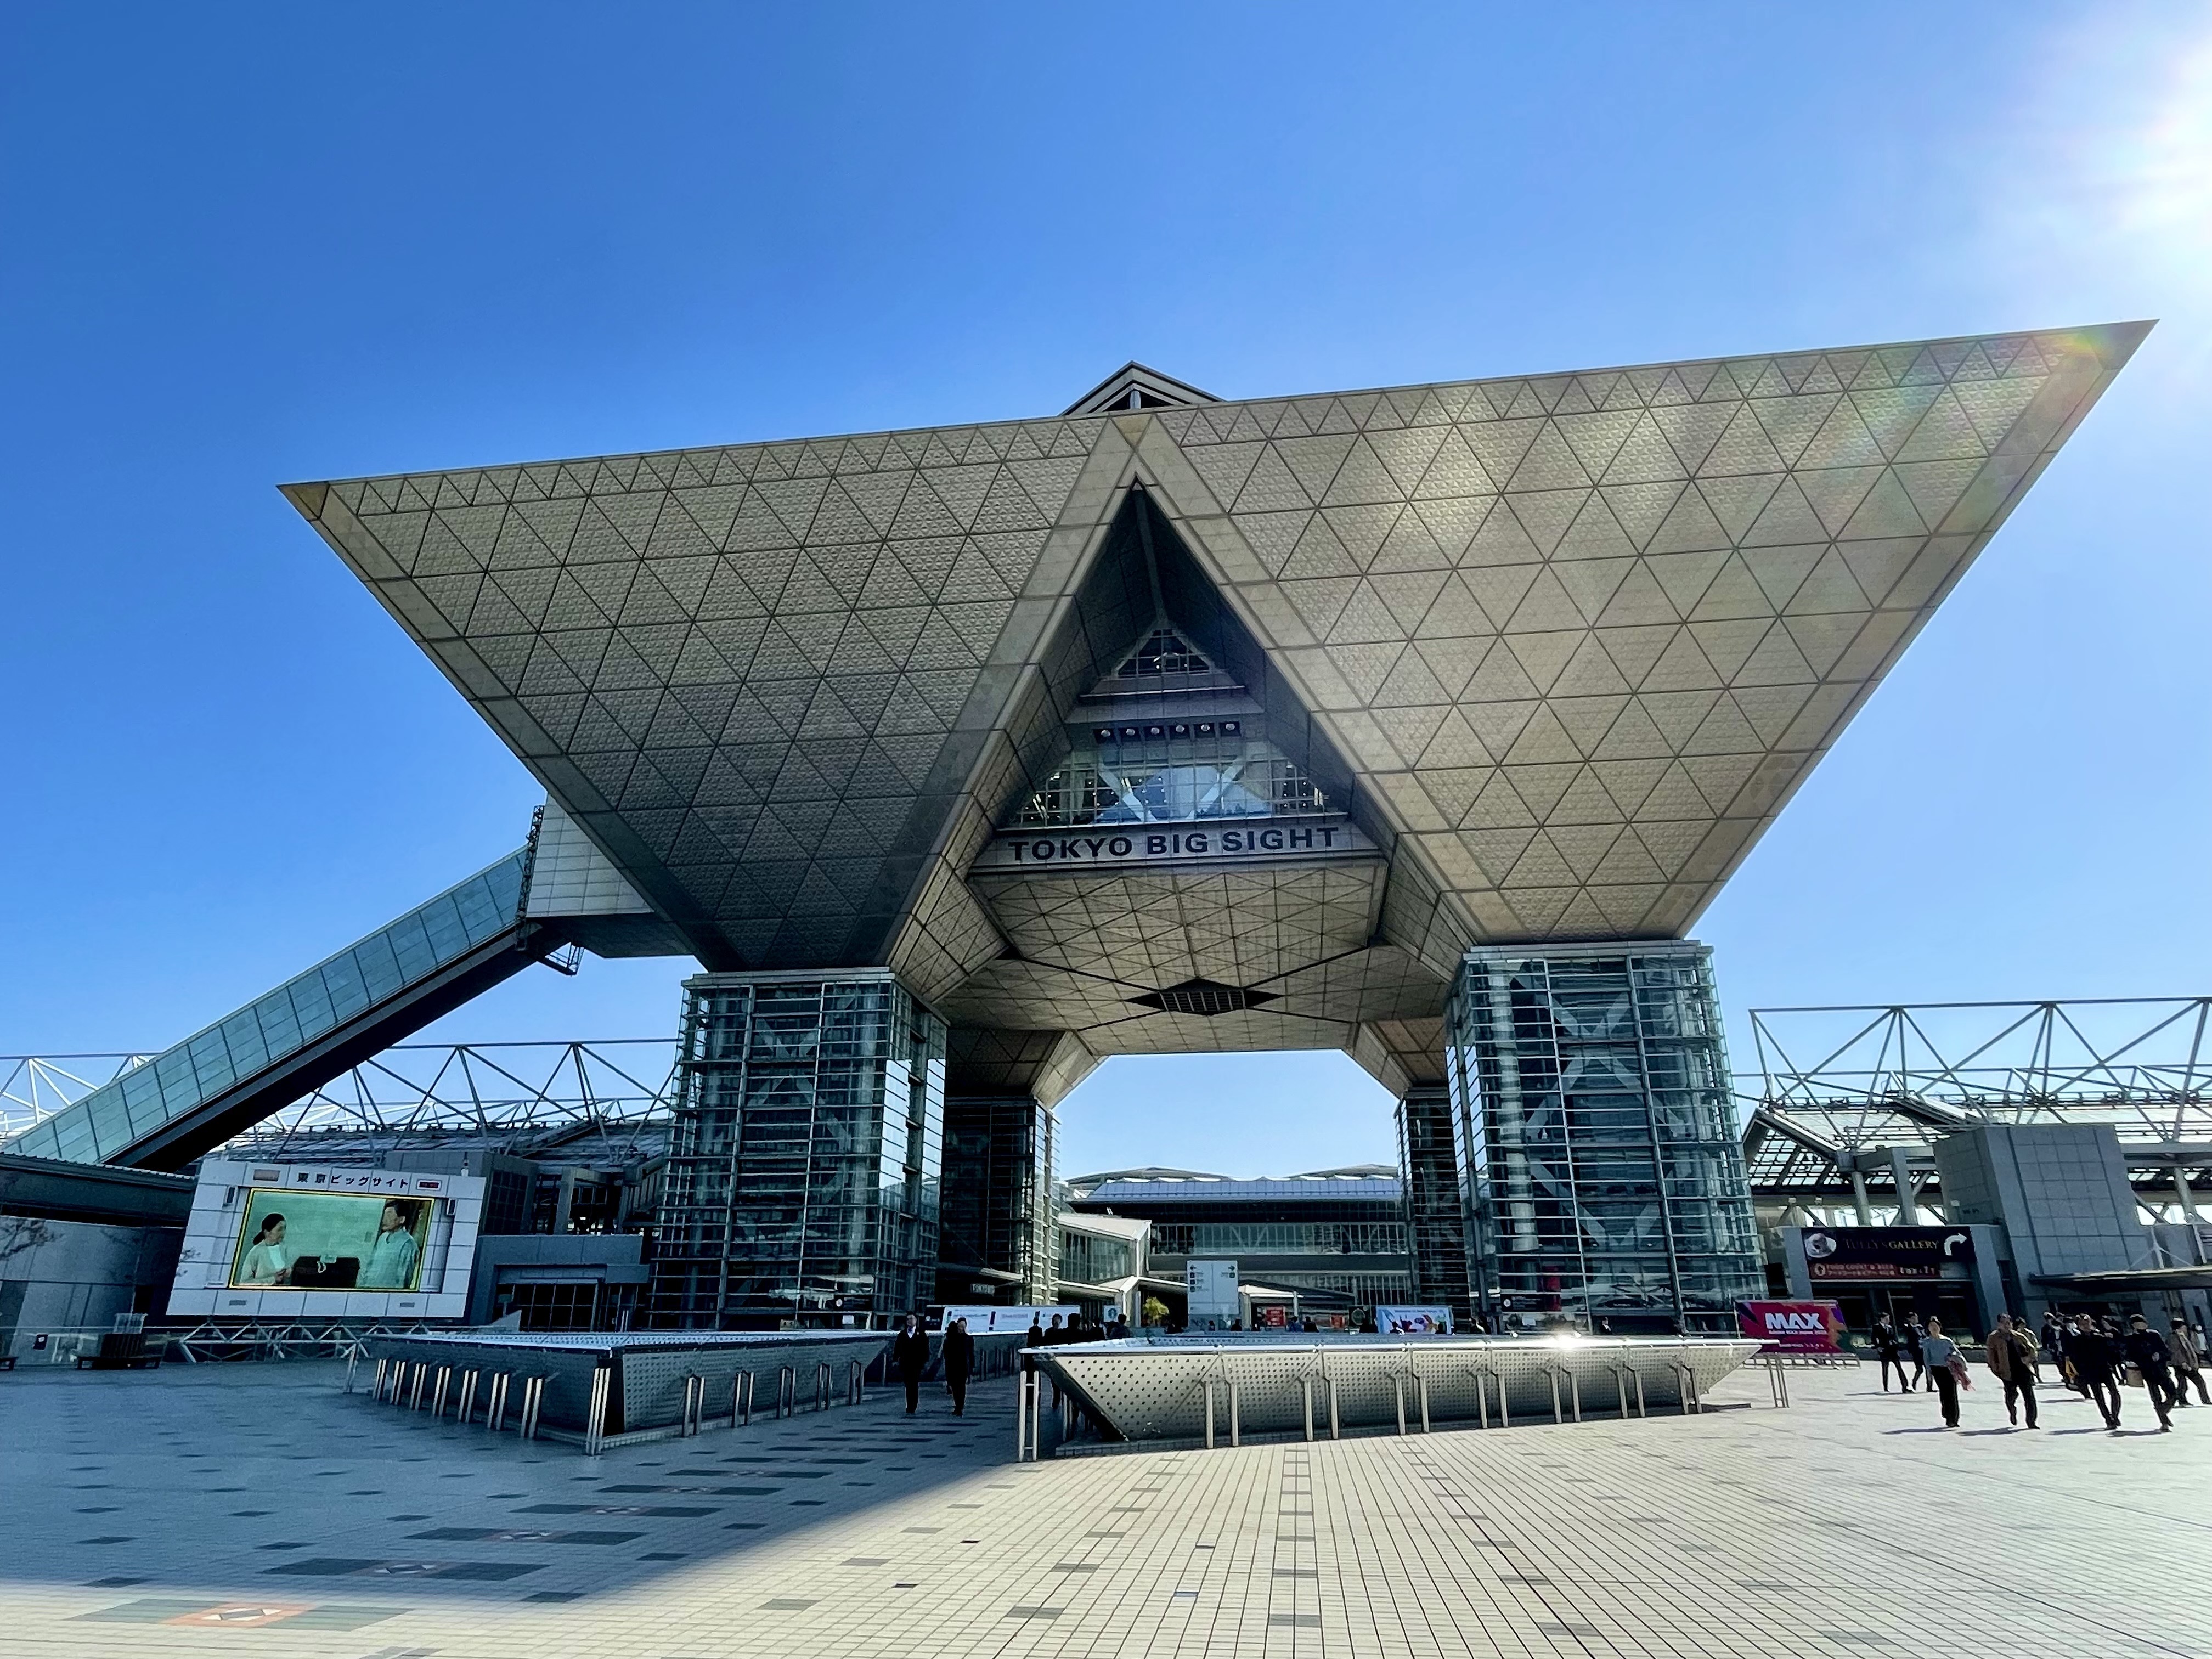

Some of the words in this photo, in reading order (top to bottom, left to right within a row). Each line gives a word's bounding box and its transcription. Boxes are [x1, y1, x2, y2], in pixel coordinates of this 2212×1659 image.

[1008, 837, 1132, 861] TOKYO
[1147, 833, 1209, 855] BIG
[1223, 827, 1339, 851] SIGHT
[297, 1172, 408, 1188] 東京ビッグサイト
[1888, 1240, 1940, 1250] GALLERY
[1765, 1312, 1825, 1330] MAX
